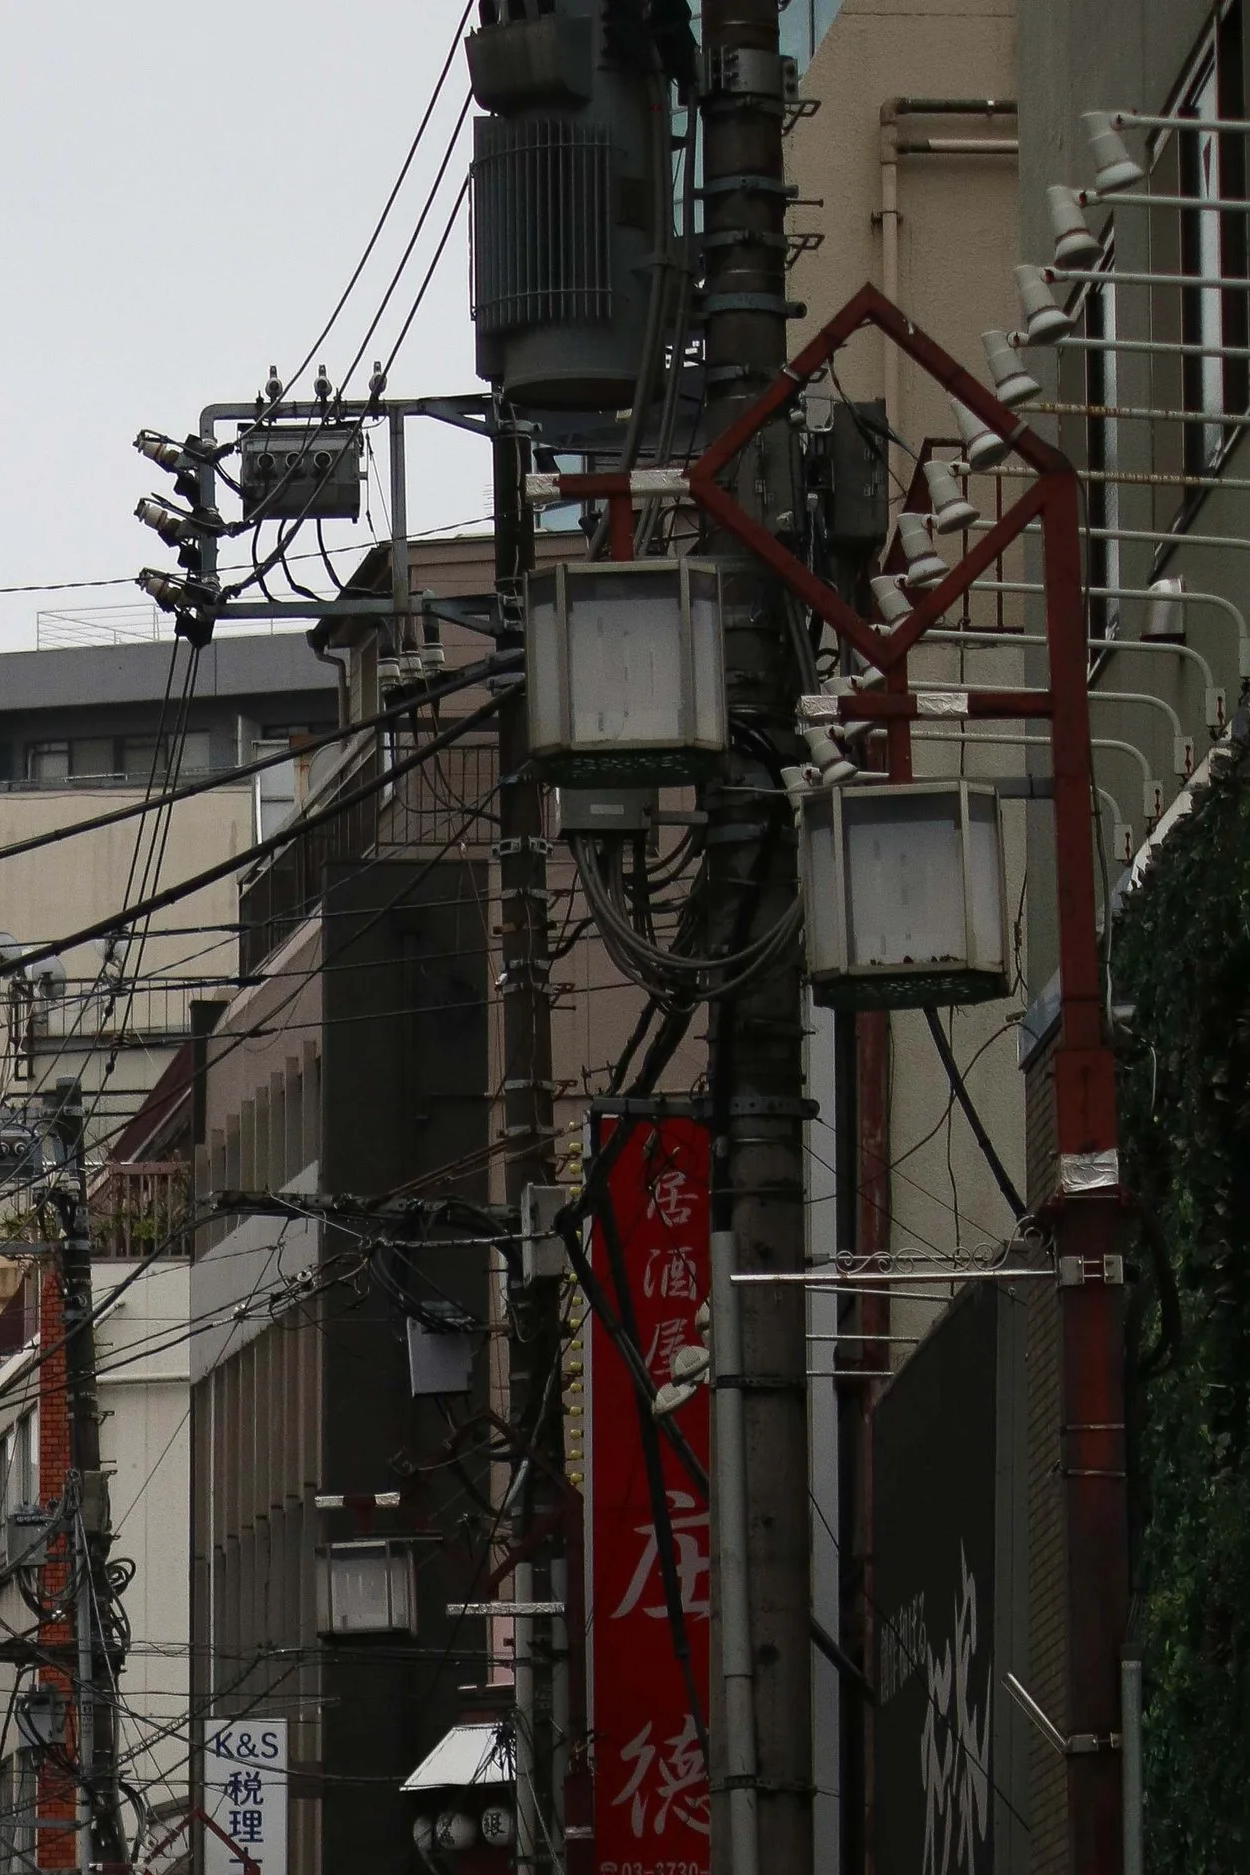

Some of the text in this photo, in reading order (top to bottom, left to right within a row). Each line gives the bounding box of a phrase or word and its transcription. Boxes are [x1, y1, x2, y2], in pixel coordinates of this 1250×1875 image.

[643, 1171, 699, 1378] 居酒屋
[215, 1732, 279, 1759] K&S
